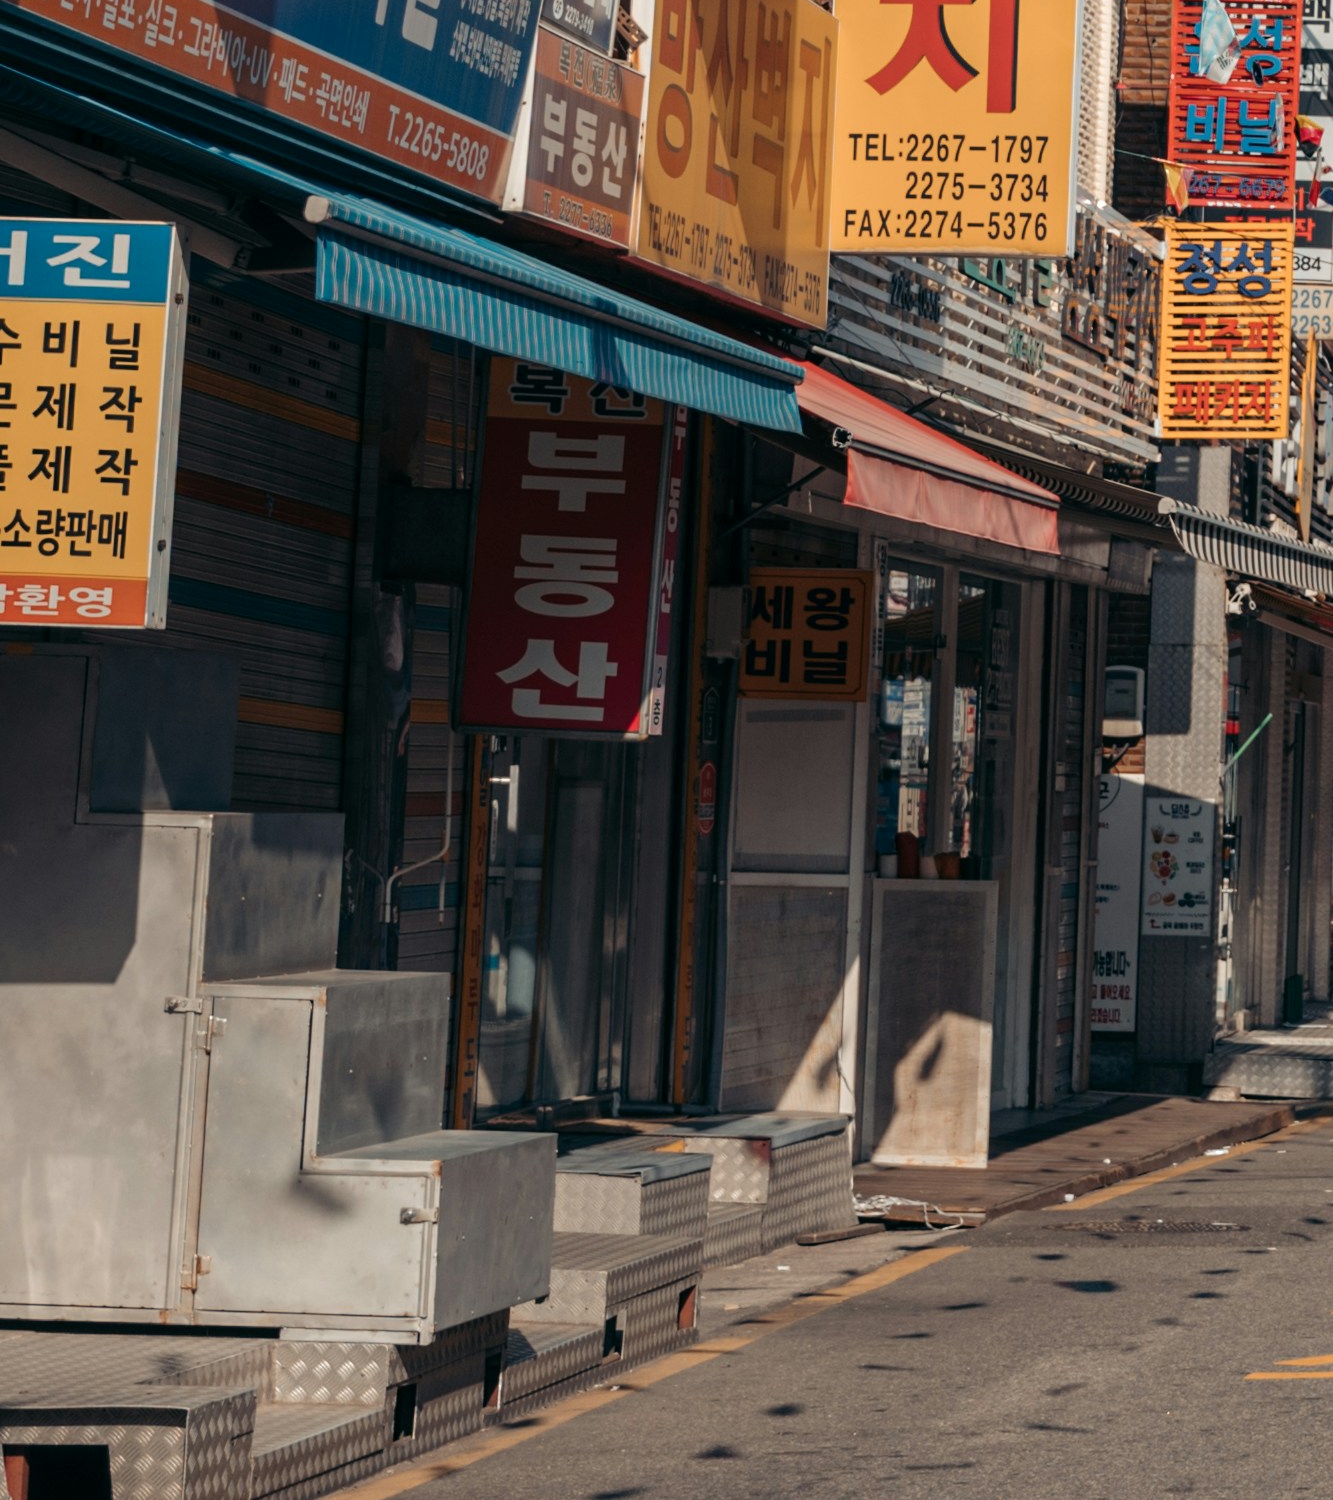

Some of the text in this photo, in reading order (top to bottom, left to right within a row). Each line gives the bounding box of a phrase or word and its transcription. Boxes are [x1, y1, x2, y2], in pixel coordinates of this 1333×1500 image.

[540, 93, 627, 198] 부동산
[1186, 96, 1284, 154] 비닐
[905, 171, 1049, 202] 2275-3734
[1188, 175, 1285, 198] 267-6679
[844, 209, 1049, 241] FAX:2274-5376
[1176, 241, 1272, 298] 정성
[1172, 315, 1279, 359] 고주파
[1174, 379, 1271, 424] 패키지
[496, 431, 626, 721] 부동산
[751, 586, 855, 631] 세왕
[745, 640, 848, 685] 비닐
